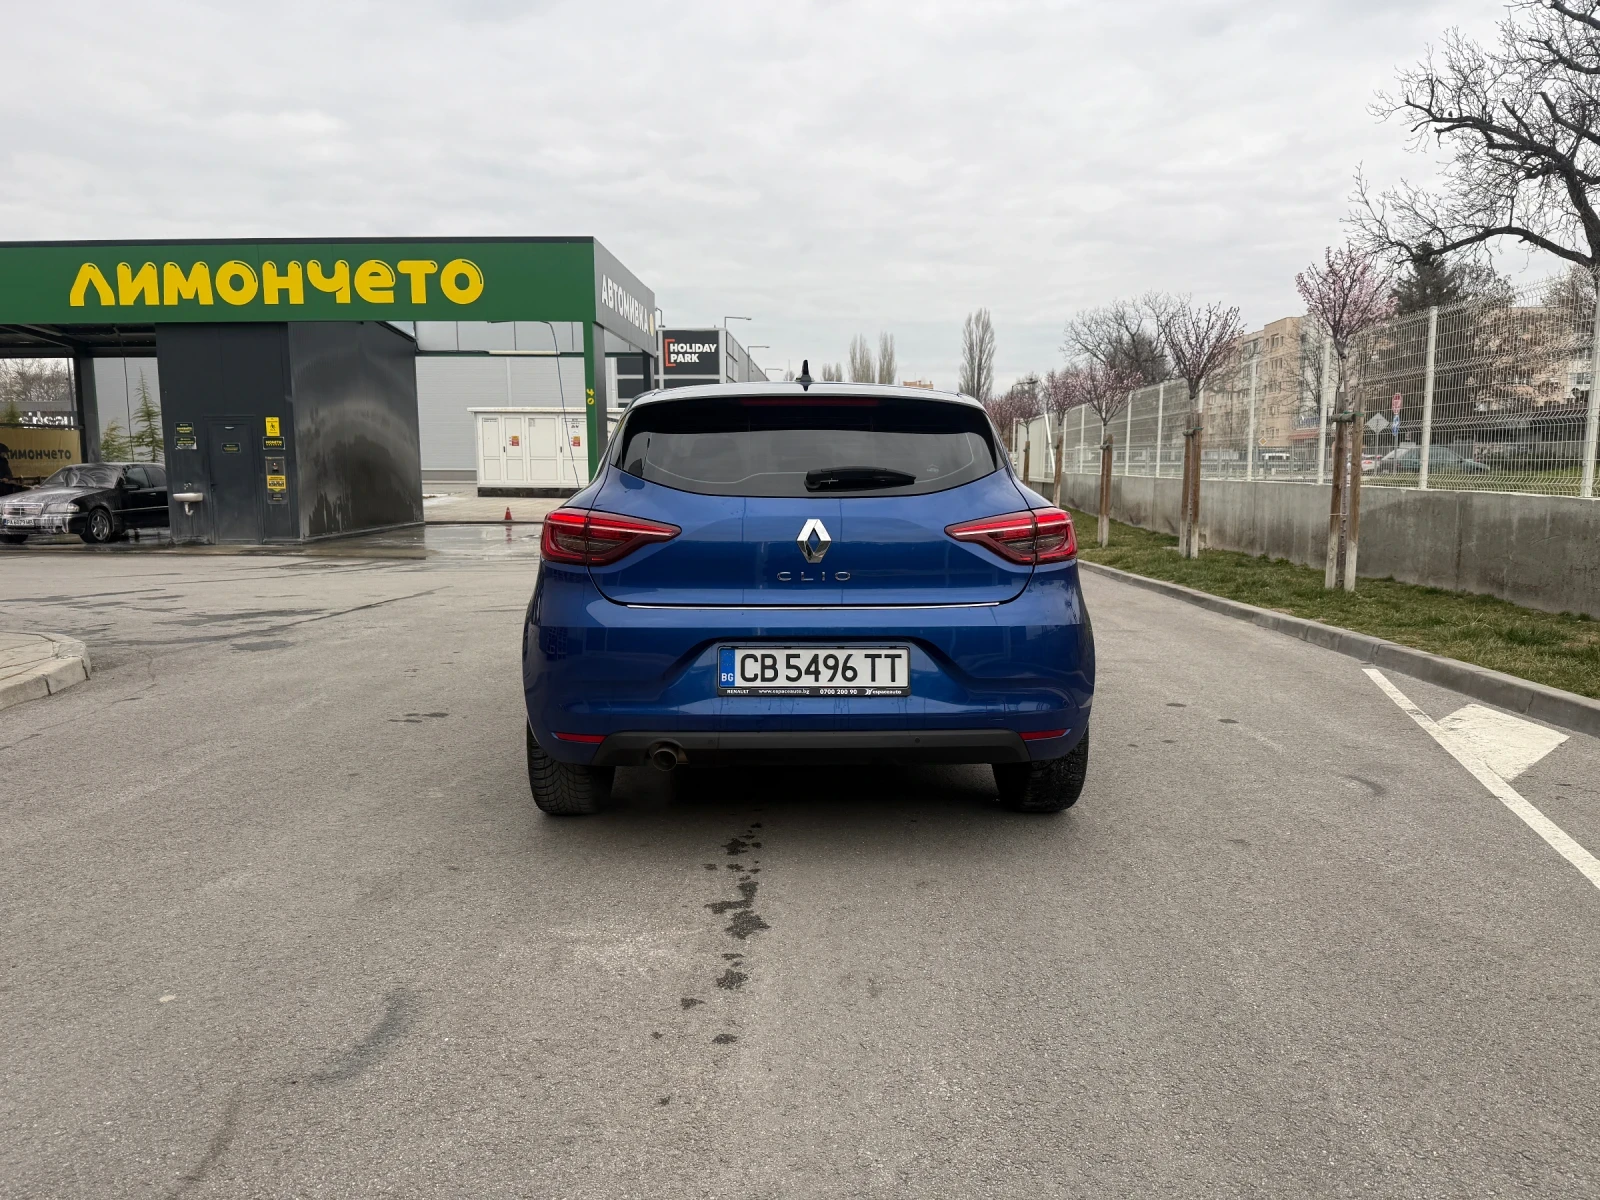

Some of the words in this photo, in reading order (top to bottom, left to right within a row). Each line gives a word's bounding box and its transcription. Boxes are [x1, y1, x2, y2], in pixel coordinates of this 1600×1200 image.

[601, 273, 649, 335] АВТОМИВКА
[669, 343, 717, 353] HOLIDAY
[670, 353, 700, 363] PARK
[776, 571, 851, 581] CLIO
[740, 653, 779, 683] CB
[785, 653, 858, 683] 5496
[864, 653, 902, 683] TT
[721, 673, 734, 682] BG
